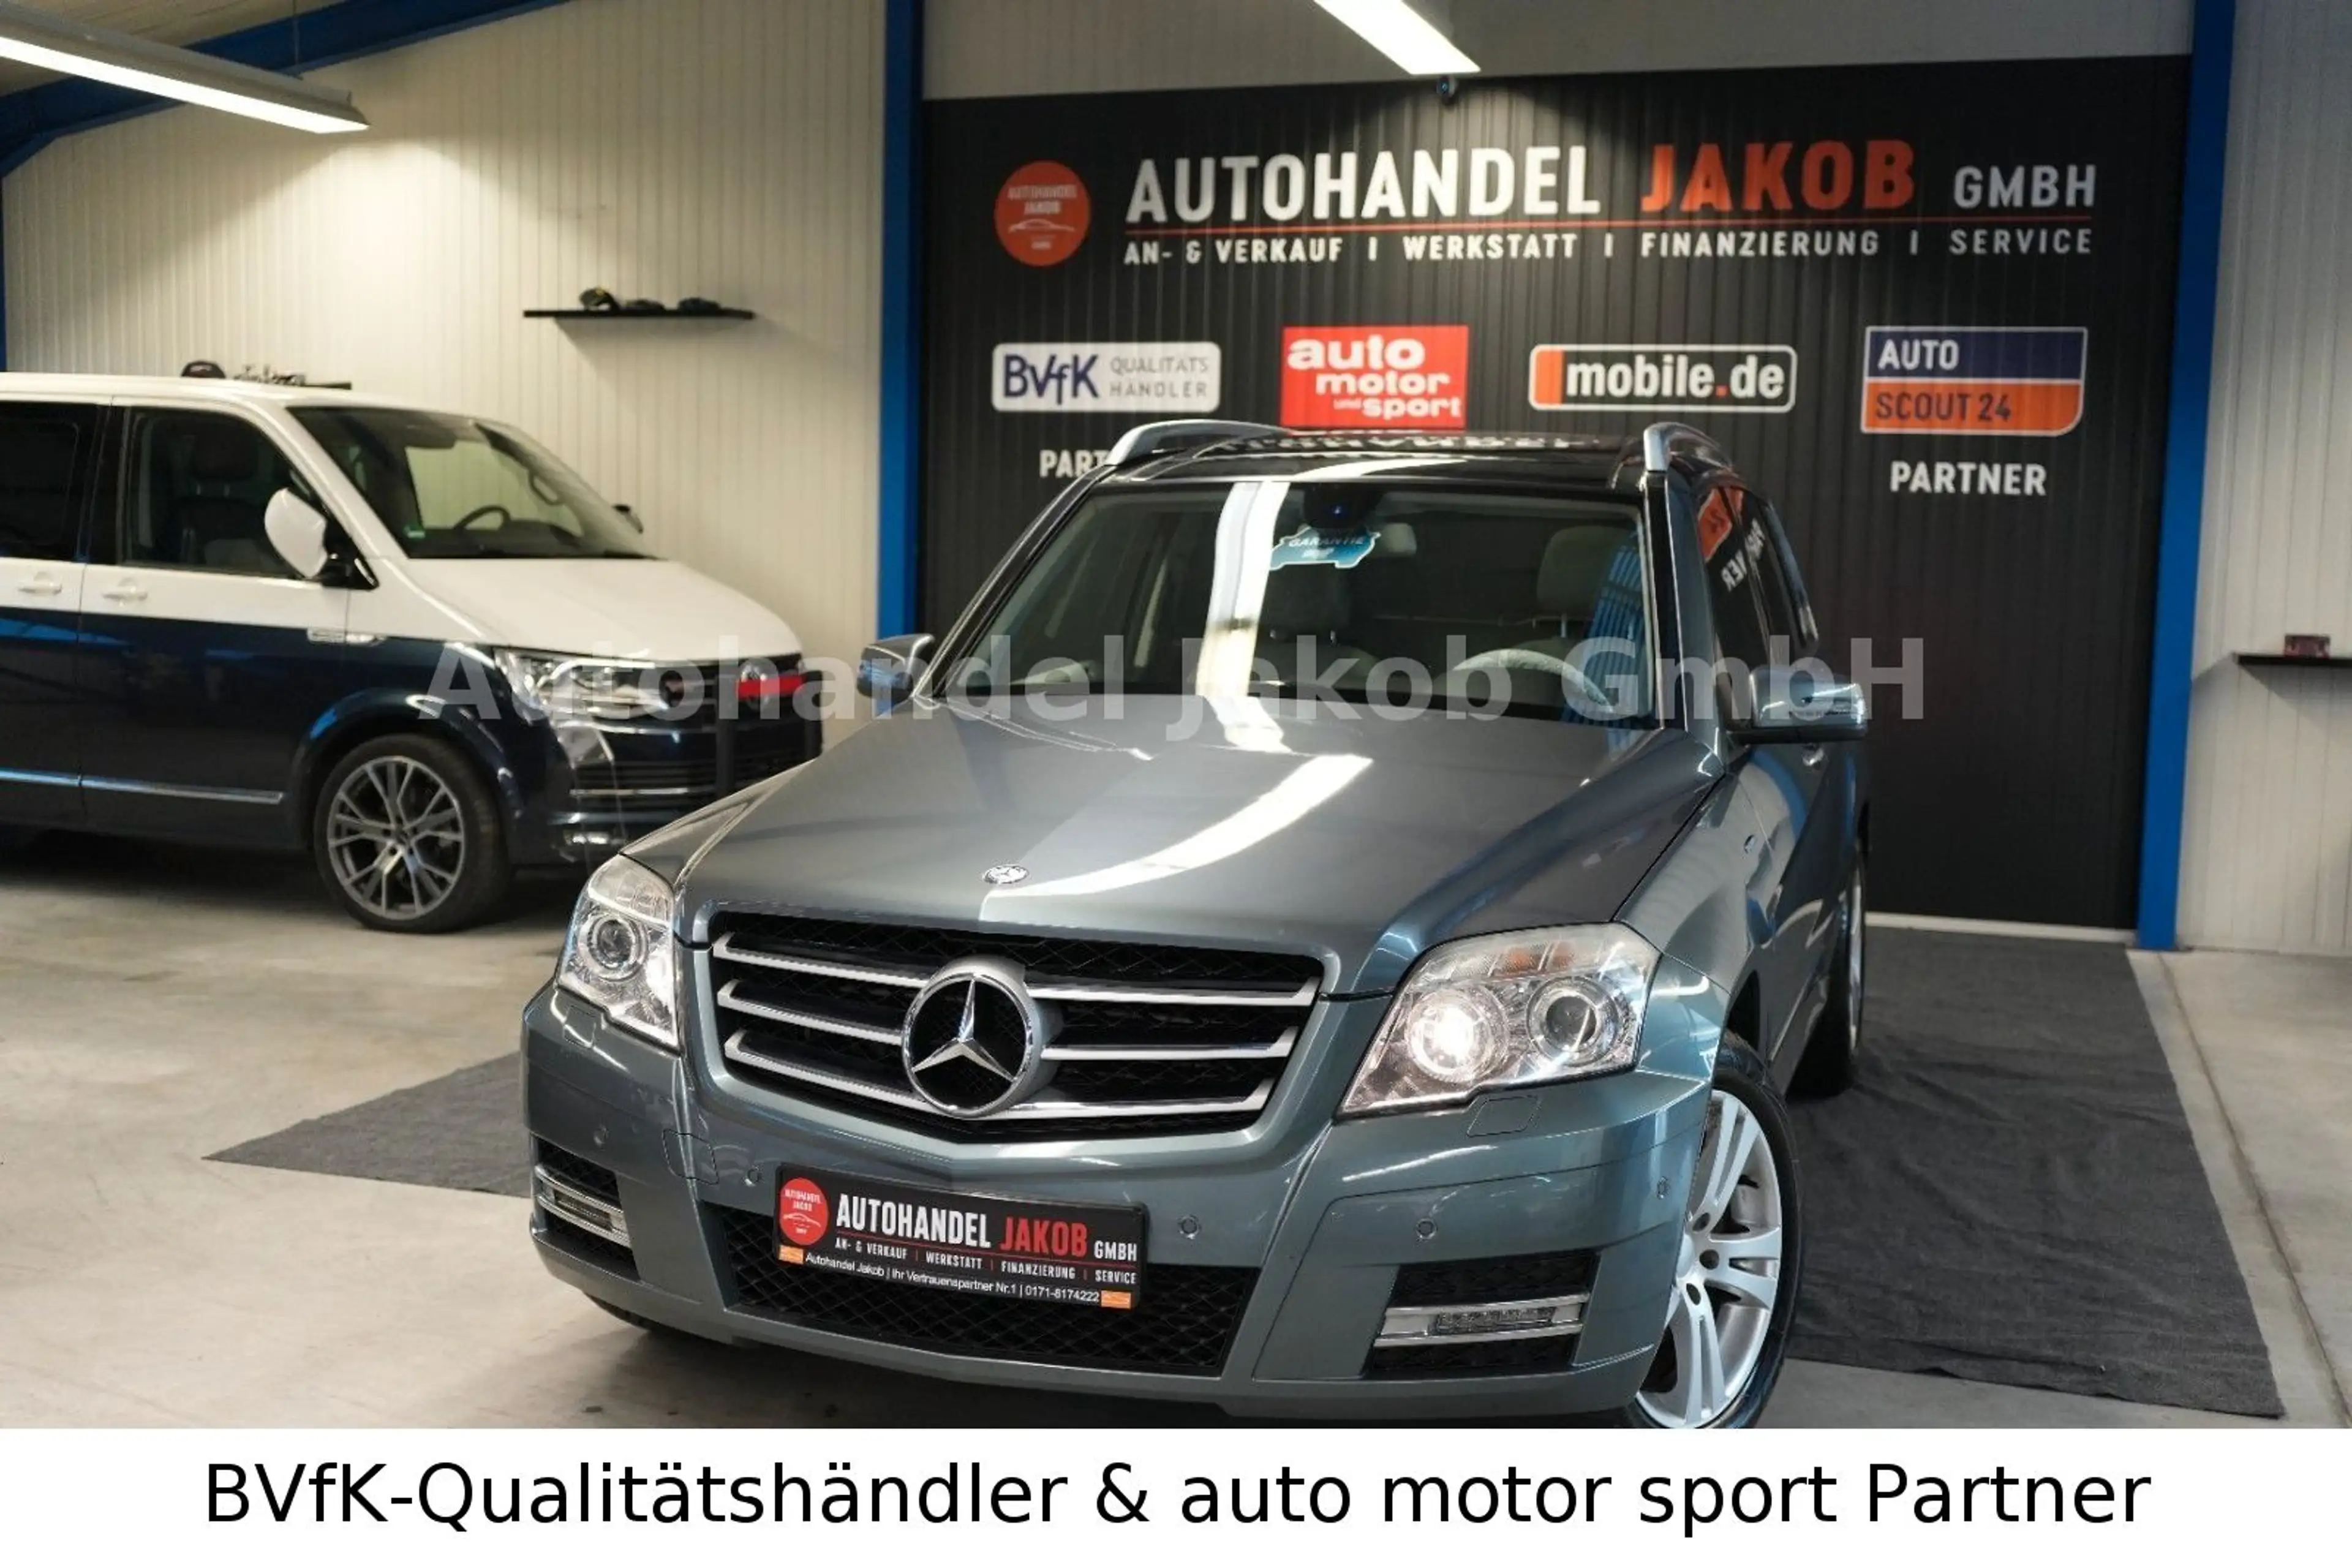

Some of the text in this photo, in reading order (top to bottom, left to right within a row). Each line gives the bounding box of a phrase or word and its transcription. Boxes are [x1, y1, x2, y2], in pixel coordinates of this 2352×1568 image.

[1126, 140, 2096, 222] AUTOHANDEL JAKOB GMBH
[1124, 241, 1172, 265] AN-
[1186, 239, 1202, 264] &
[1216, 238, 1343, 263] VERKAUF
[1403, 233, 1578, 262] WERKSTATT
[1641, 230, 1879, 258] FINANZIERUNG
[1950, 228, 2092, 255] SERVICE
[1287, 334, 1426, 370] auto
[1877, 339, 1959, 370] AUTO
[1003, 353, 1099, 405] BVfK
[1316, 371, 1451, 395] motor
[1566, 353, 1785, 398] mobile.de
[1362, 397, 1461, 420] sport
[1876, 393, 2012, 422] SCOUT 24
[1891, 460, 2046, 496] PARTNER
[835, 1193, 1137, 1262] AUTOHANDEL JAKOB GMBH
[805, 1253, 856, 1272] Autohandel
[857, 1263, 884, 1276] Jakob
[892, 1268, 905, 1280] Ihr
[906, 1270, 993, 1293] Vertrauenspartner
[867, 1243, 908, 1260] VERKAUF
[925, 1251, 983, 1270] WERKSTATT
[1001, 1261, 1076, 1280] FINANZIERUNG
[1095, 1270, 1137, 1284] SERVICE
